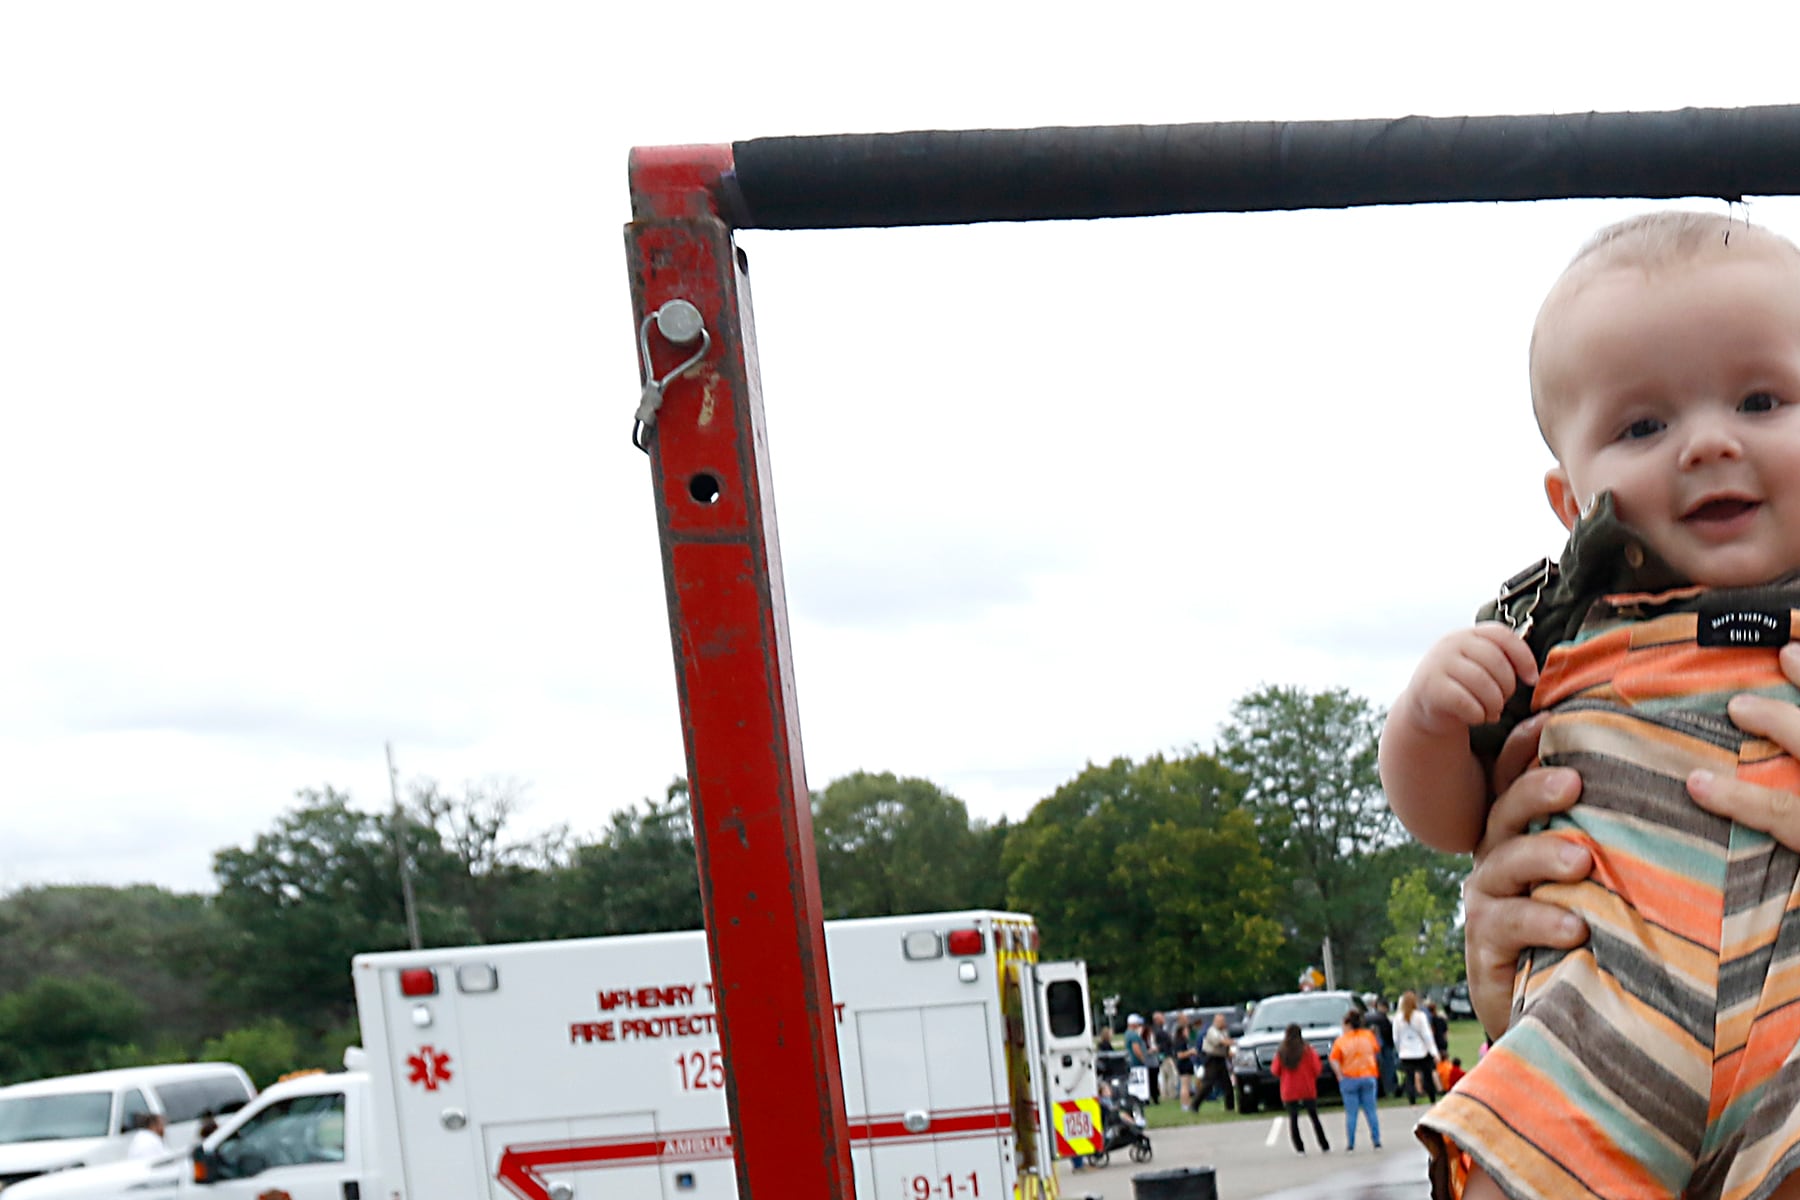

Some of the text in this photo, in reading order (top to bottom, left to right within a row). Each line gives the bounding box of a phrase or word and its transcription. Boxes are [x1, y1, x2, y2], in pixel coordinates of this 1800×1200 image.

[1730, 629, 1760, 642] CHILD
[571, 1014, 717, 1044] FIRE PROTECT
